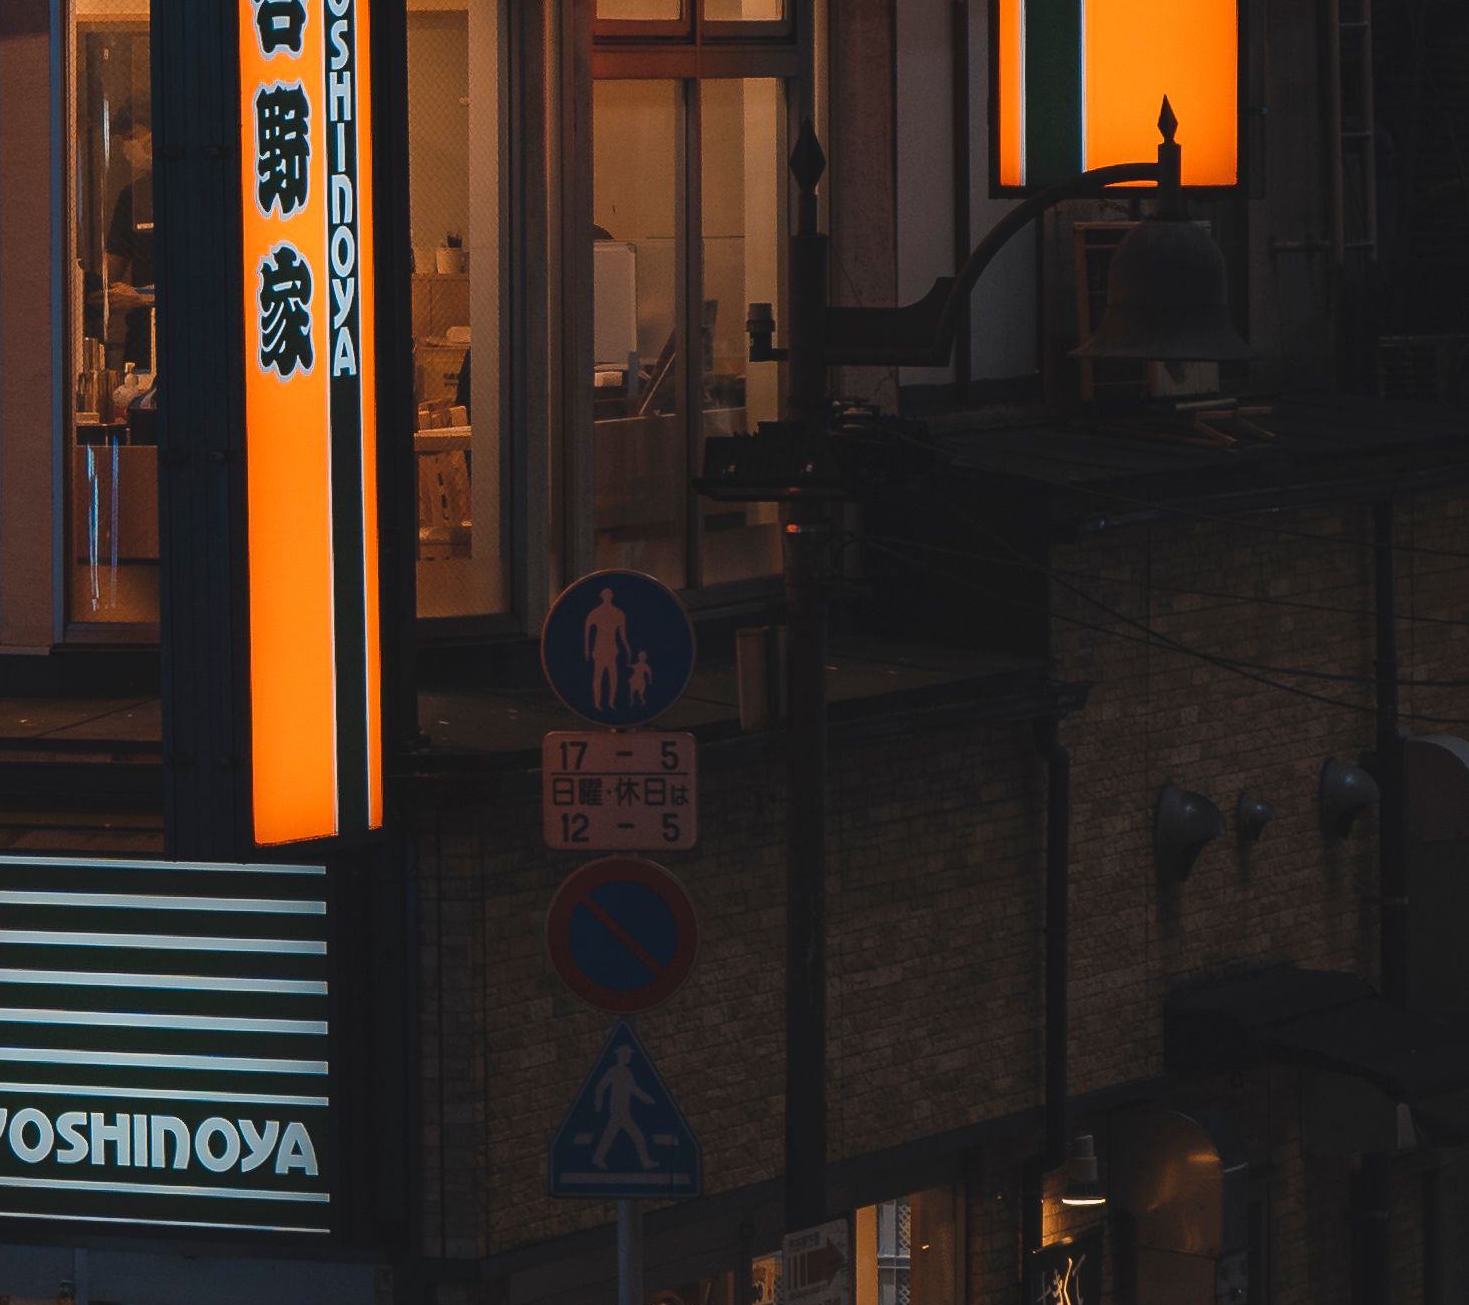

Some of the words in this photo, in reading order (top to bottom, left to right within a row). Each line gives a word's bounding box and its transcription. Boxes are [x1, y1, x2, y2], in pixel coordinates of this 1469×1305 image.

[559, 741, 587, 771] 17
[660, 741, 679, 770] 5
[562, 813, 590, 843] 12
[661, 813, 680, 843] 5
